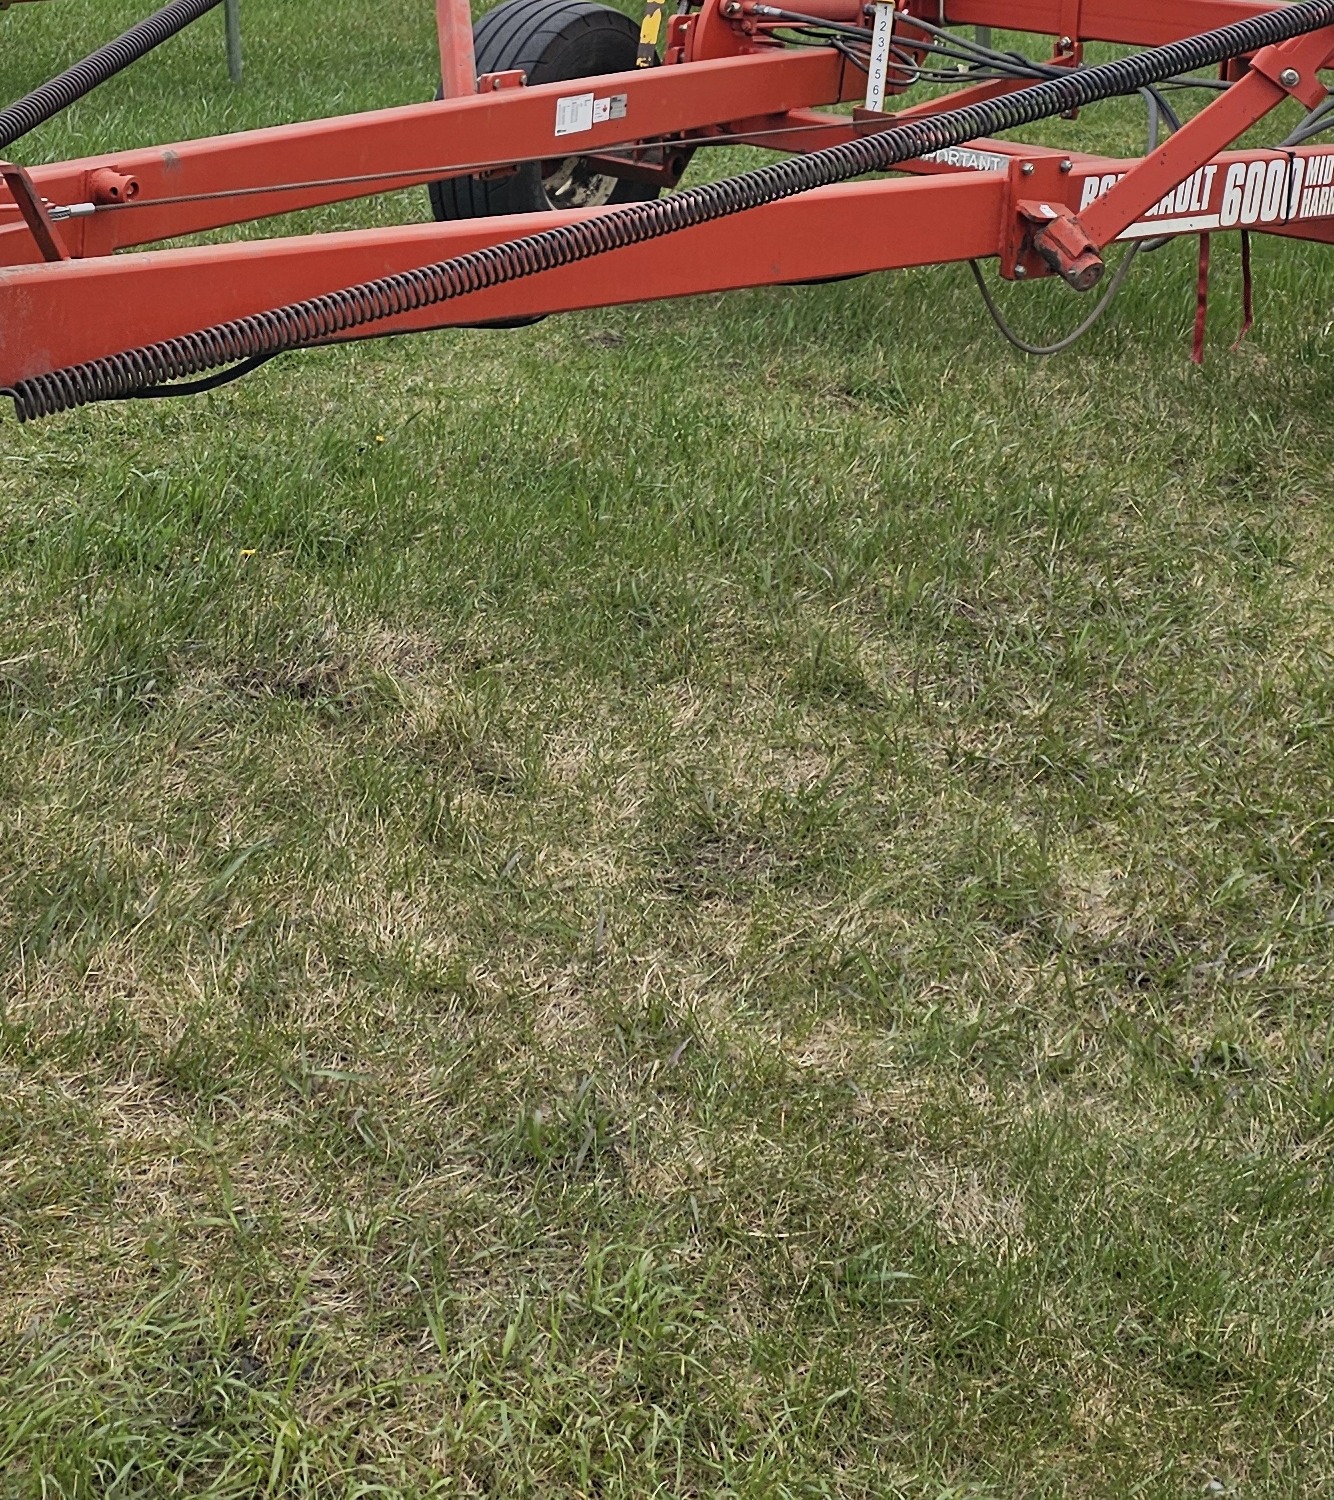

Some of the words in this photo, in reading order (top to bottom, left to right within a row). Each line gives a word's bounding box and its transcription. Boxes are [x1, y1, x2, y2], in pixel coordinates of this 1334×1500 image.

[883, 5, 888, 16] 1
[879, 21, 887, 32] 2
[878, 37, 885, 48] 3
[875, 53, 882, 63] 4
[874, 69, 881, 80] 5
[872, 85, 879, 95] 6
[871, 101, 878, 111] 7
[1219, 158, 1305, 227] 6000
